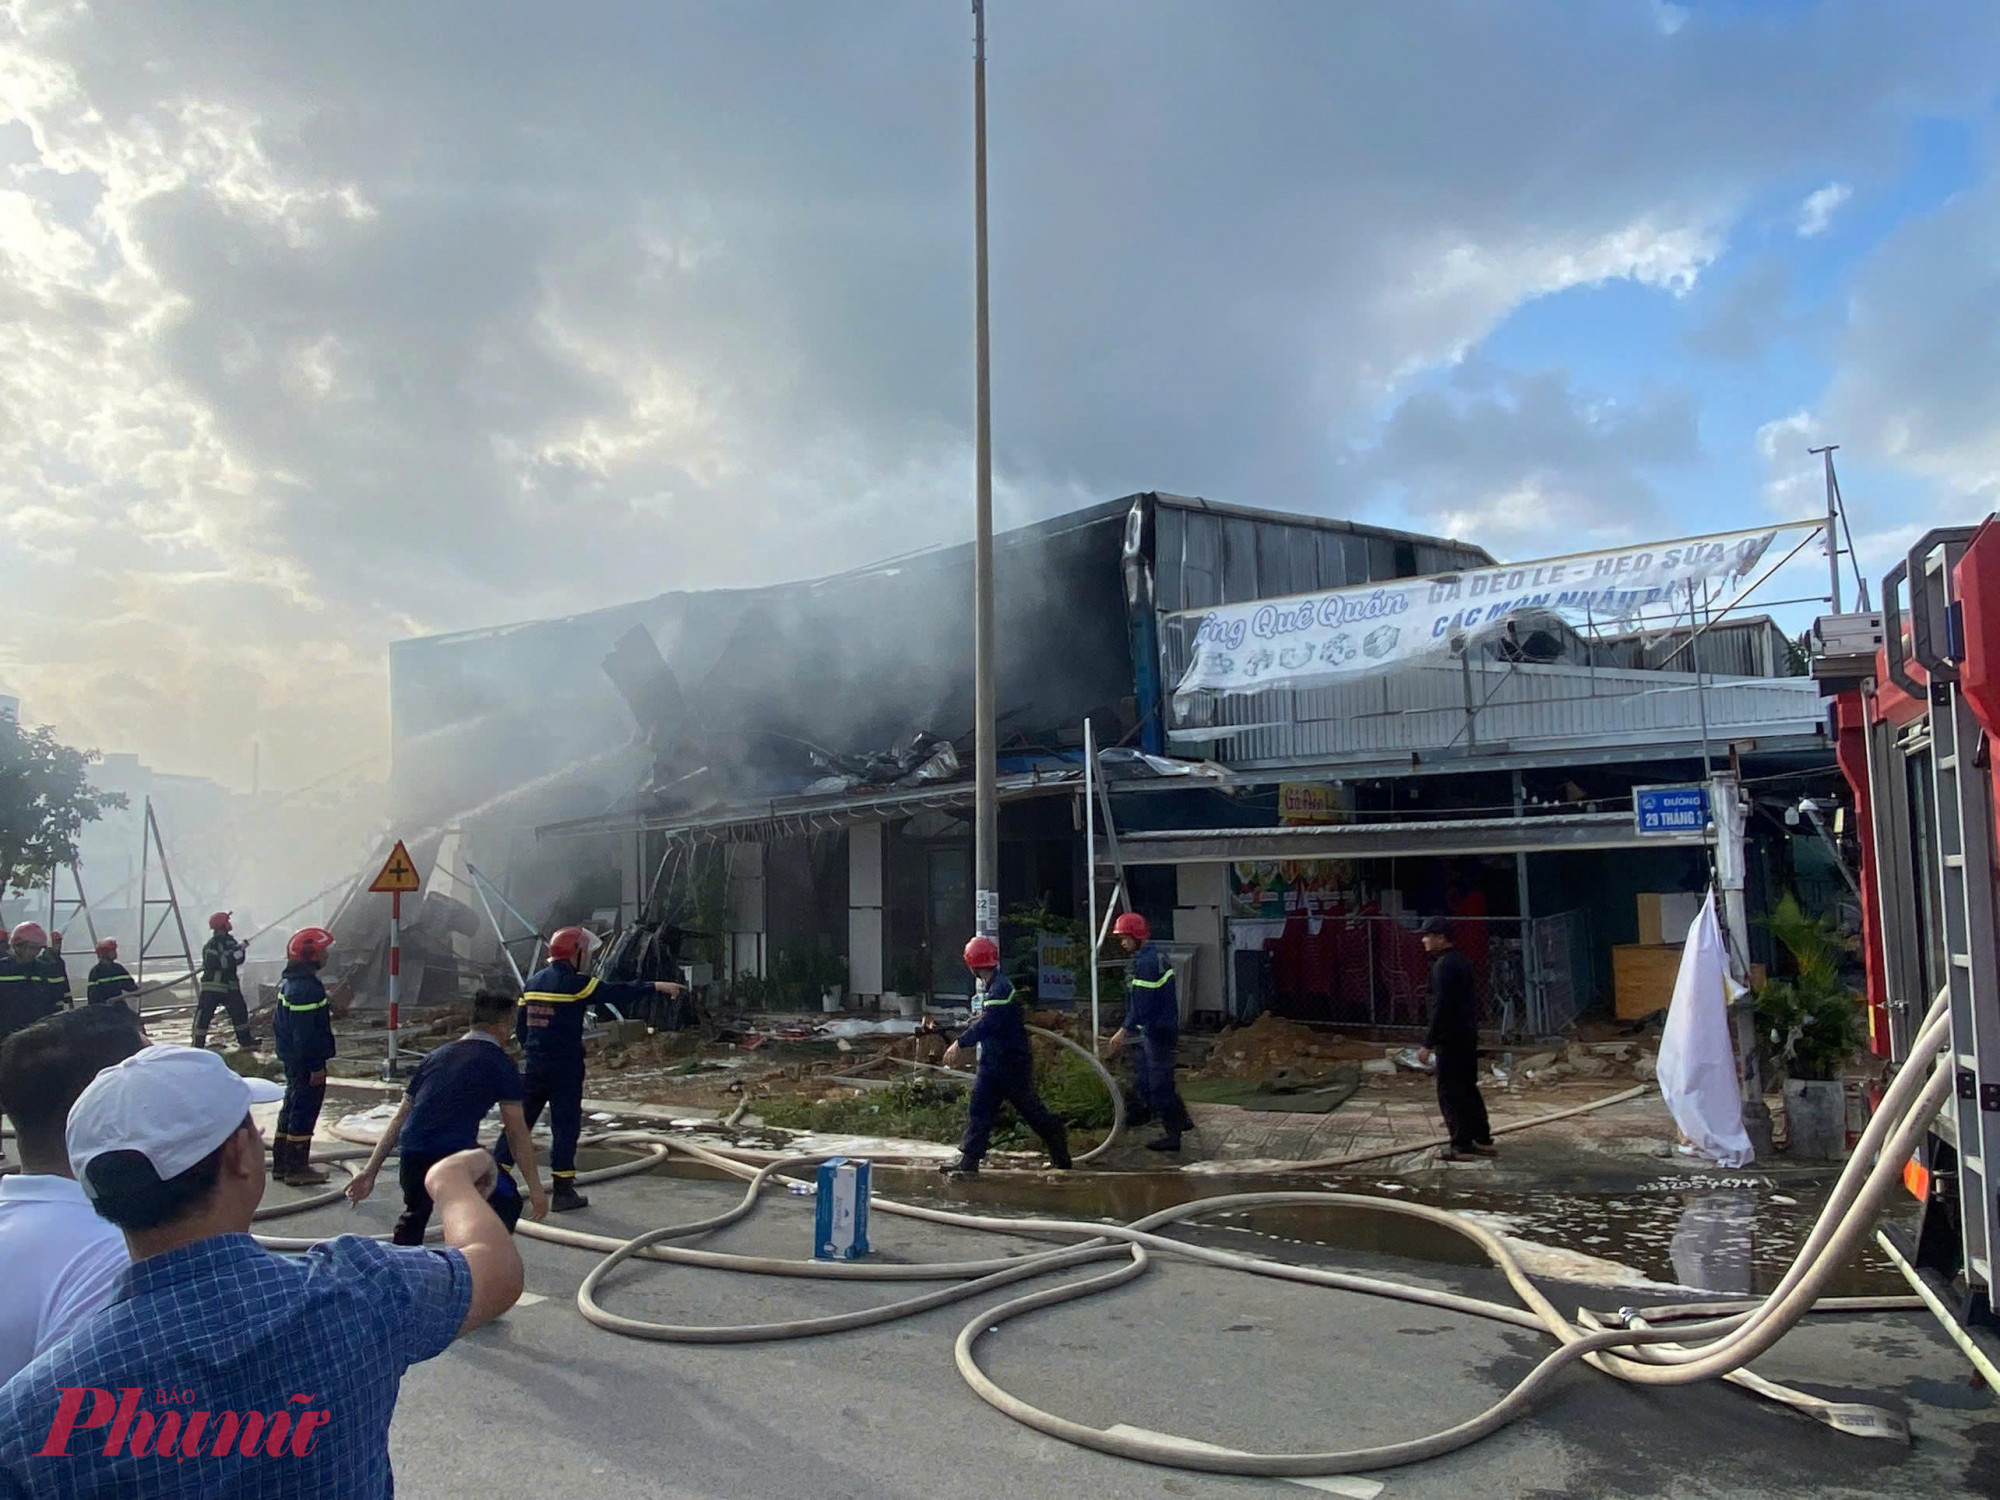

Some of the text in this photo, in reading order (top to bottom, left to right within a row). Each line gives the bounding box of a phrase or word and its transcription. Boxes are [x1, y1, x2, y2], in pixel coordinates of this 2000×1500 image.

[1252, 600, 1315, 640] Quê
[1317, 589, 1409, 629] Quán
[1432, 606, 1483, 638] CÁC
[1663, 794, 1701, 807] ĐƯỜNG
[1645, 812, 1659, 827] 29
[1660, 808, 1695, 826] THÁNG
